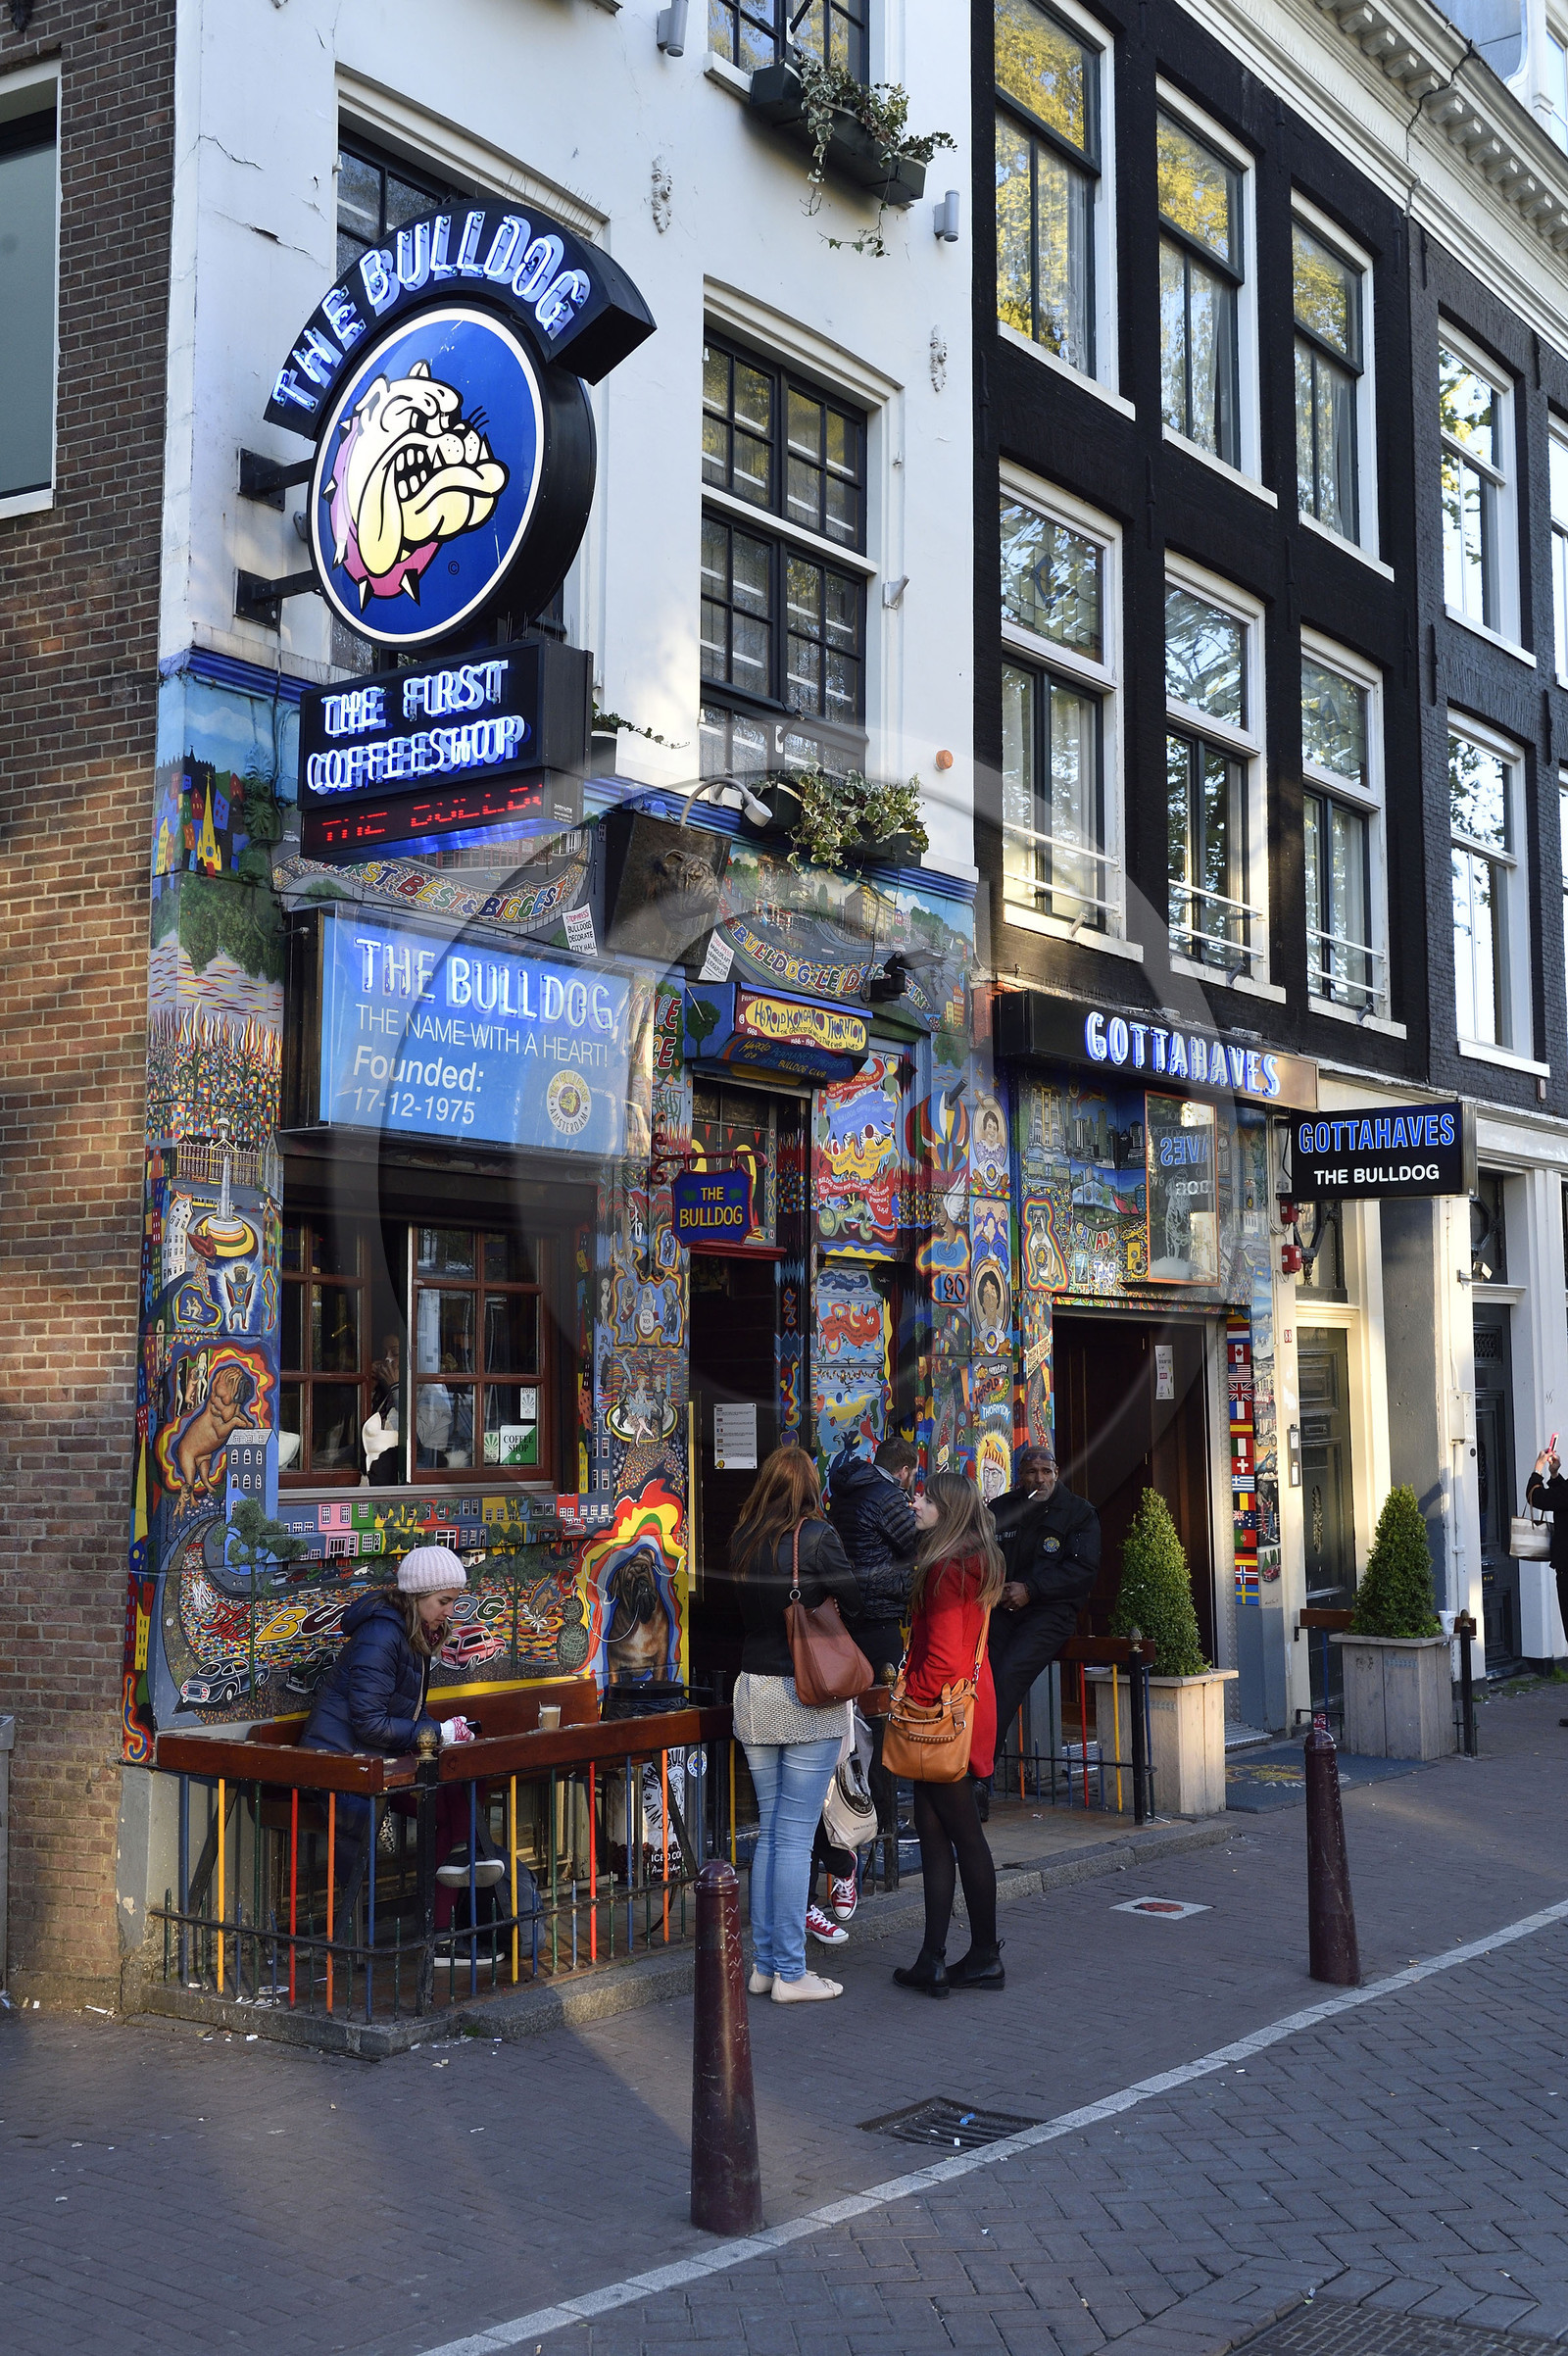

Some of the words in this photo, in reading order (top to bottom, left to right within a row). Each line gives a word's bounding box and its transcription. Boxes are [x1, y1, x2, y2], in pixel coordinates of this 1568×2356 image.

[272, 285, 367, 413] THE
[360, 211, 591, 340] BULLDOG
[321, 687, 388, 737] THE
[403, 660, 509, 720] FIRST
[307, 715, 526, 794] COFFEESHOP
[397, 874, 469, 910] BEST
[478, 880, 567, 920] BIGGEST
[733, 923, 811, 985] BULLDOG
[354, 935, 437, 1002] THE
[446, 955, 614, 1032] BULLDOG
[356, 1003, 400, 1037] THE
[405, 1012, 466, 1047] NAME
[466, 1019, 520, 1055] WITH
[523, 1033, 538, 1057] A
[542, 1036, 609, 1069] HEART!
[1084, 1009, 1279, 1098] GOTTAHAVES
[353, 1045, 486, 1093] Founded:
[354, 1087, 476, 1126] 17-12-1975
[549, 1107, 589, 1134] AMSTERDAM
[1298, 1111, 1455, 1154] GOTTAHAVES
[700, 1186, 724, 1203] THE
[1313, 1166, 1349, 1186] THE
[1353, 1163, 1440, 1184] BULLDOG
[679, 1204, 744, 1229] BULLDOG
[1075, 1222, 1116, 1252] CANADA
[945, 1273, 965, 1301] 90
[503, 1435, 534, 1444] COFFEE
[508, 1444, 529, 1452] SHOP
[201, 1601, 253, 1643] The
